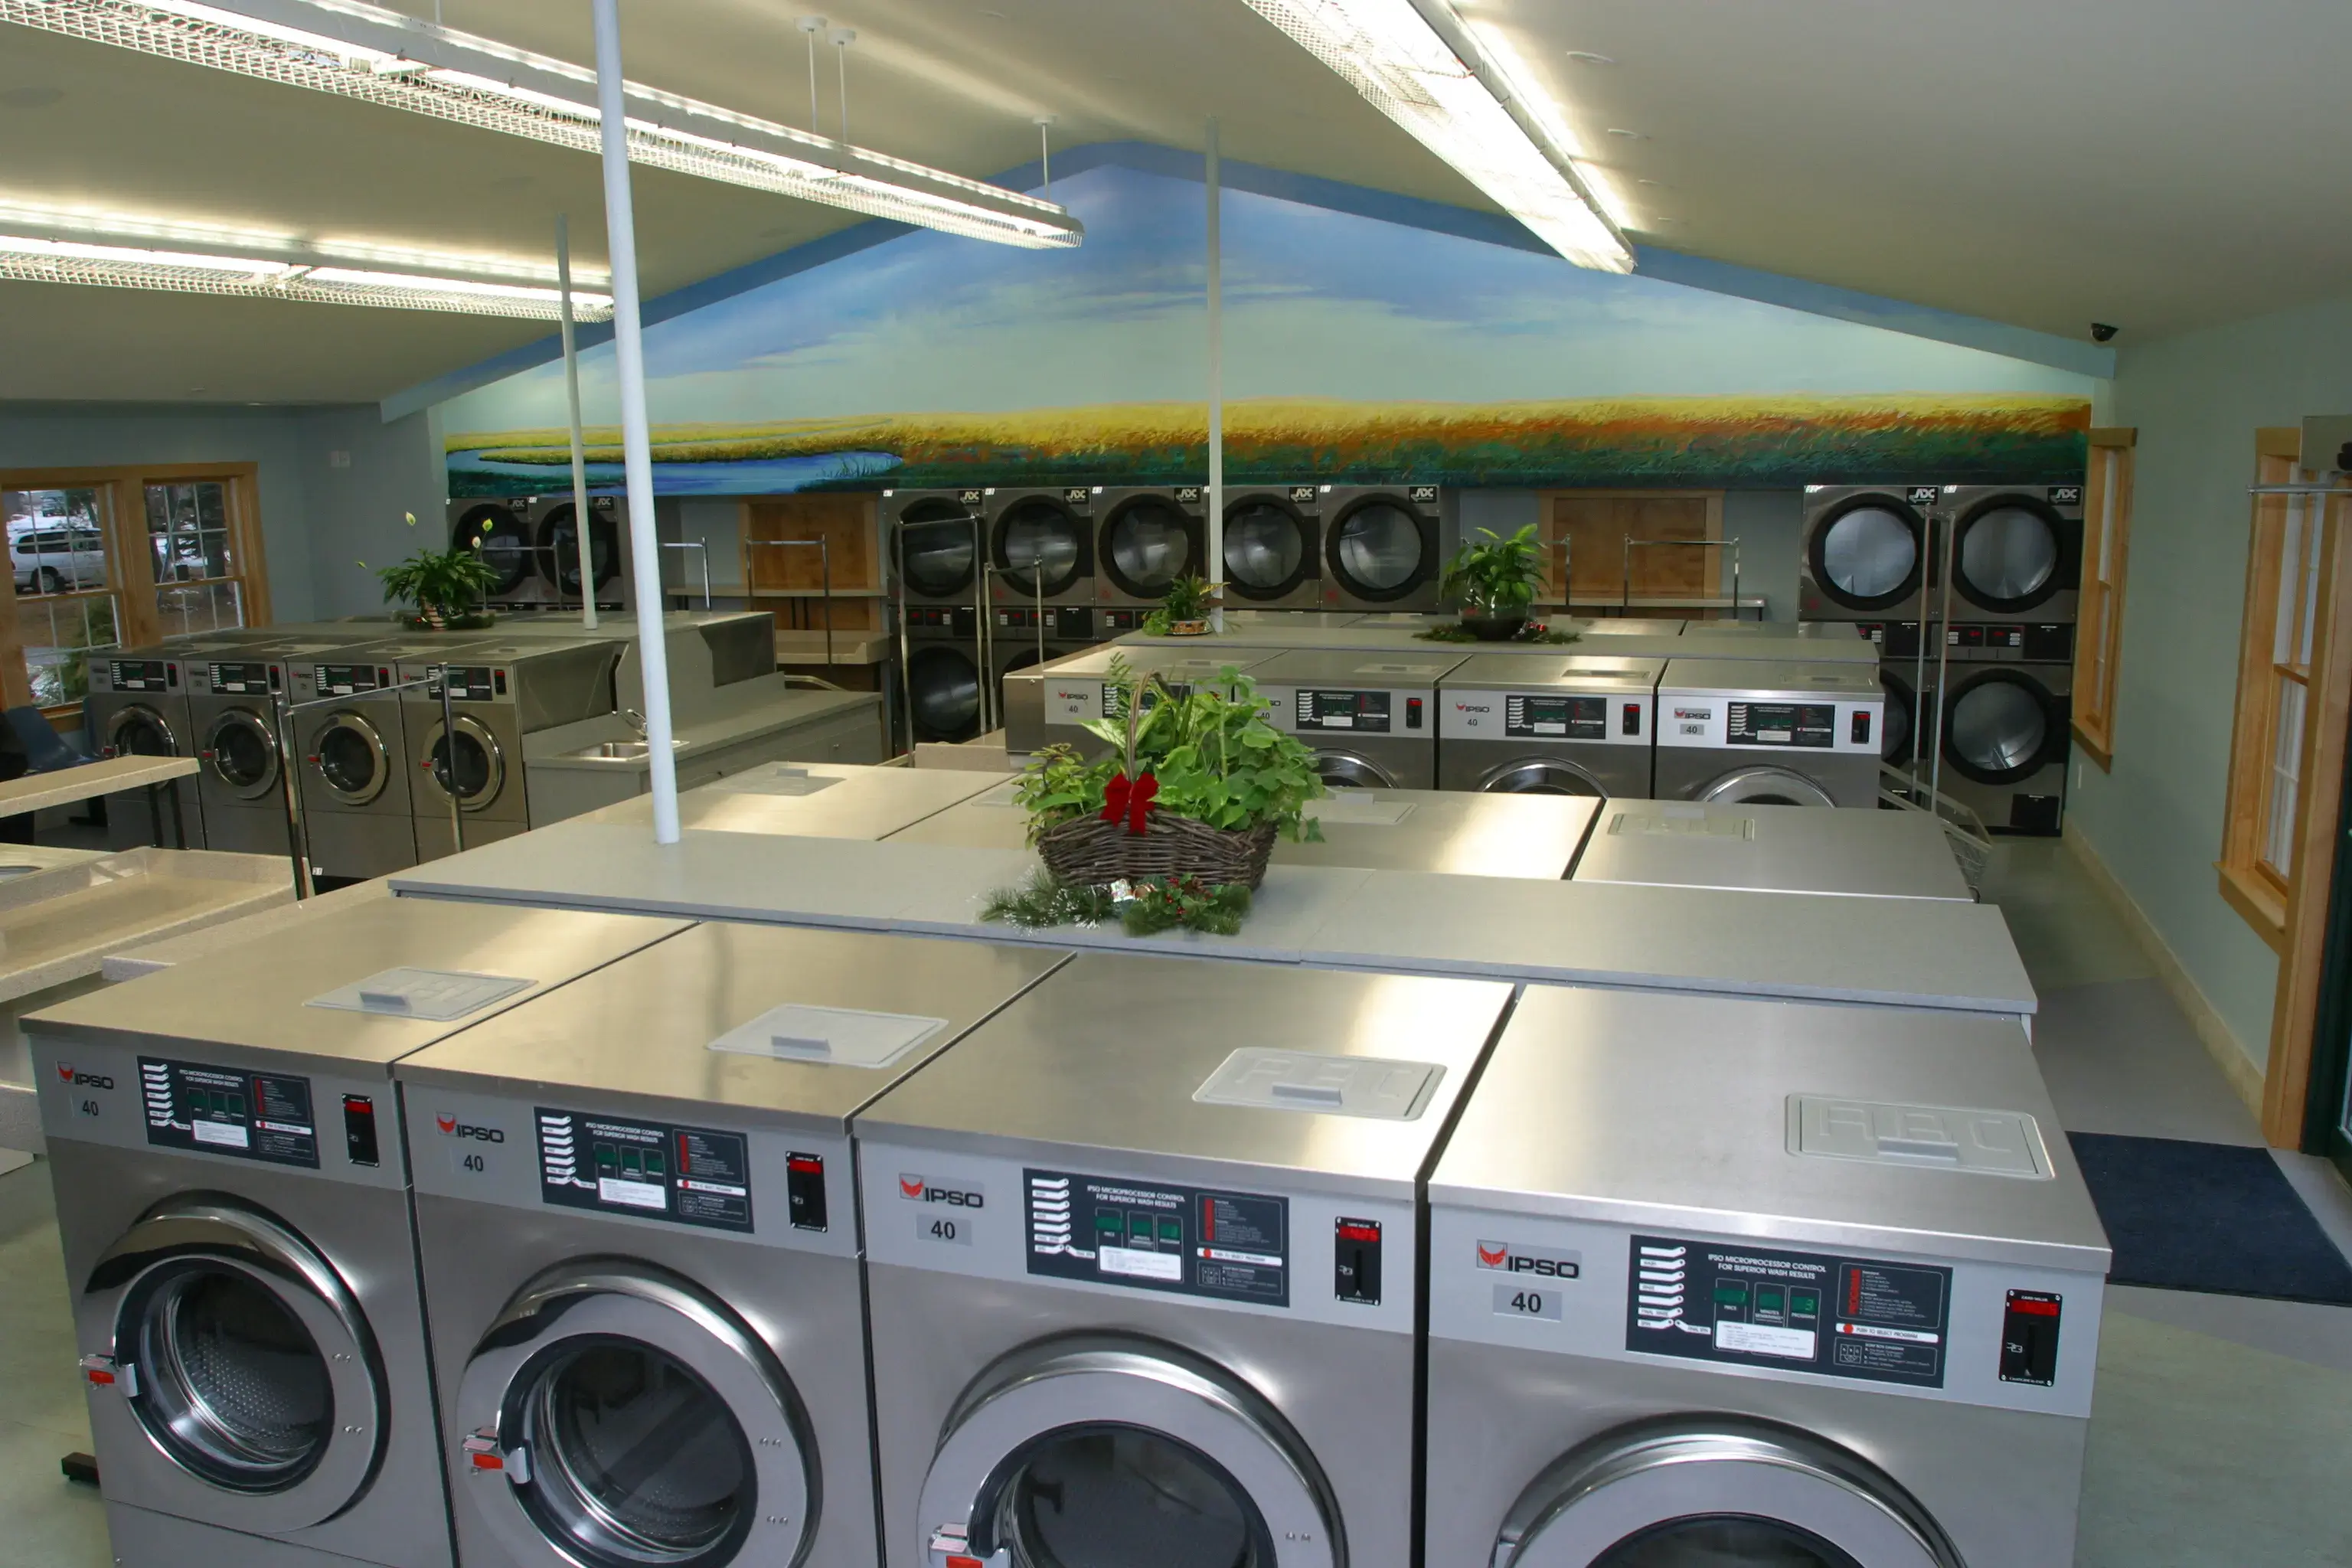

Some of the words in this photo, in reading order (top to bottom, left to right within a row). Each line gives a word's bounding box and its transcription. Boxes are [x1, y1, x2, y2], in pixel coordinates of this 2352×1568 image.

[74, 1073, 114, 1089] IPSO
[83, 1100, 99, 1116] 40
[456, 1124, 505, 1143] IPSO
[464, 1155, 483, 1171] 40
[925, 1187, 983, 1208] IPSO
[1157, 1193, 1185, 1202] CONTROL
[931, 1220, 956, 1240] 40
[1508, 1256, 1579, 1279] IPSO
[1708, 1253, 1724, 1262] IPSO
[1725, 1256, 1791, 1269] MICROPROCESSOR
[1792, 1262, 1827, 1272] CONTROL
[1734, 1265, 1767, 1275] SUPERIOR
[1768, 1268, 1788, 1277] WASH
[1789, 1270, 1816, 1279] RESULTS
[1511, 1292, 1541, 1313] 40
